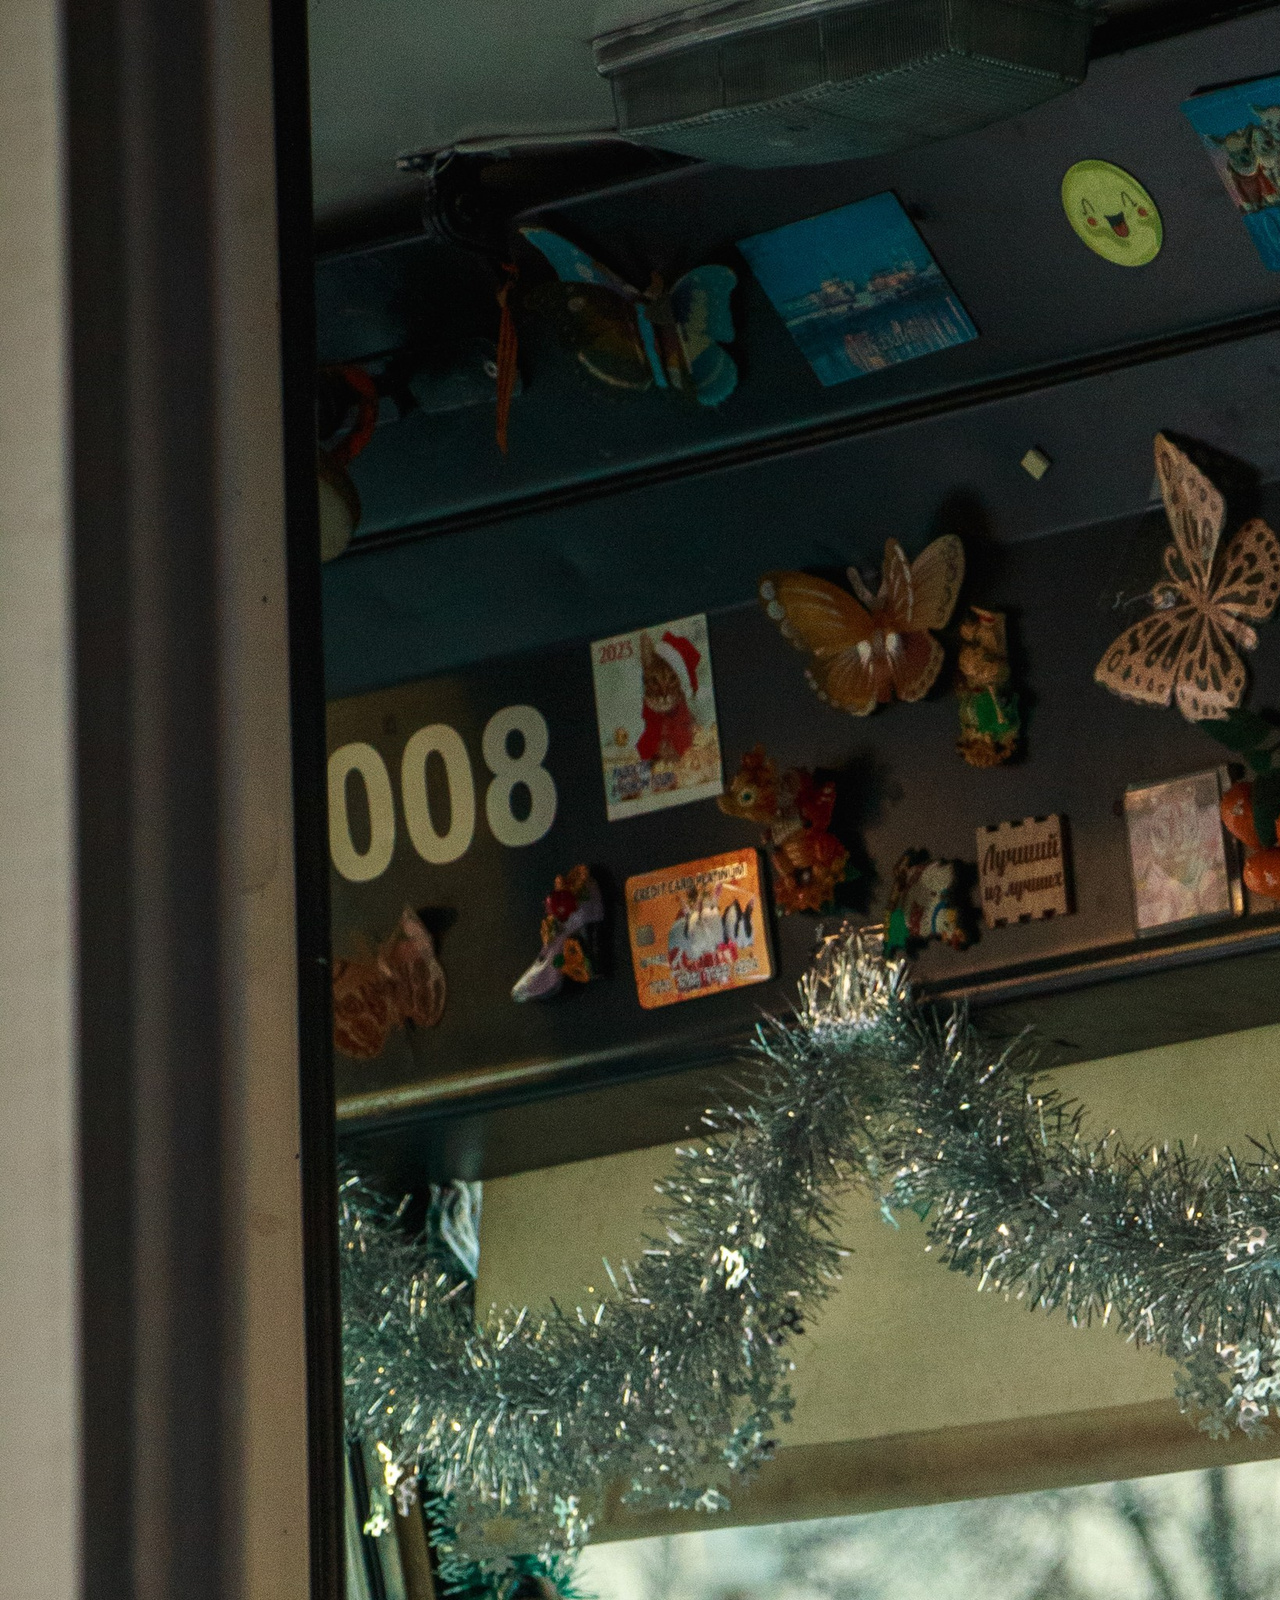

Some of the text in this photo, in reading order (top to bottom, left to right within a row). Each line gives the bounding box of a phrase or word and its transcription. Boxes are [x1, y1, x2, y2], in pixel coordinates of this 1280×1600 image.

[327, 704, 558, 883] 008
[982, 834, 1059, 876] Лучший
[632, 882, 667, 902] CREDIT
[668, 876, 696, 894] CARD
[984, 872, 1063, 905] из лучших
